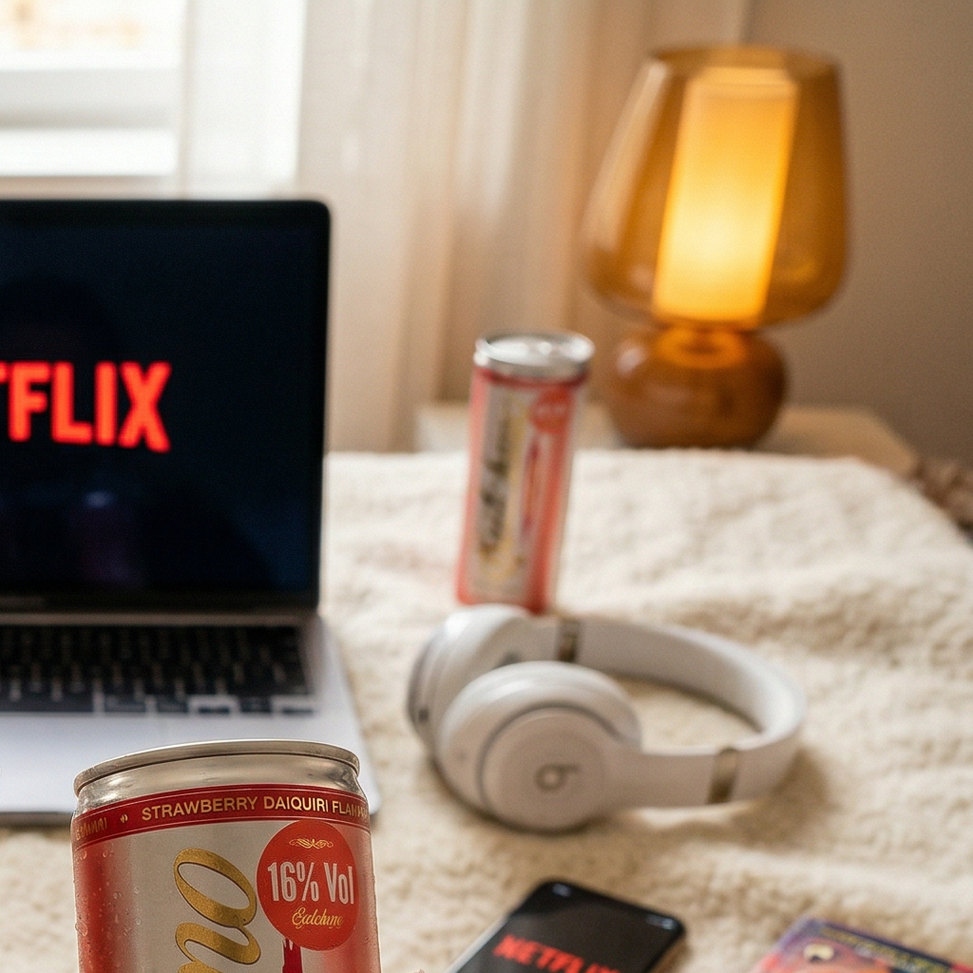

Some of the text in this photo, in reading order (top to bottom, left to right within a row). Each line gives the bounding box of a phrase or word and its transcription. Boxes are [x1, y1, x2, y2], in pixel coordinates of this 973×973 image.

[142, 796, 258, 821] STRAWBERRY
[263, 796, 329, 812] DAIQUIRI
[268, 861, 354, 904] 16% Vol
